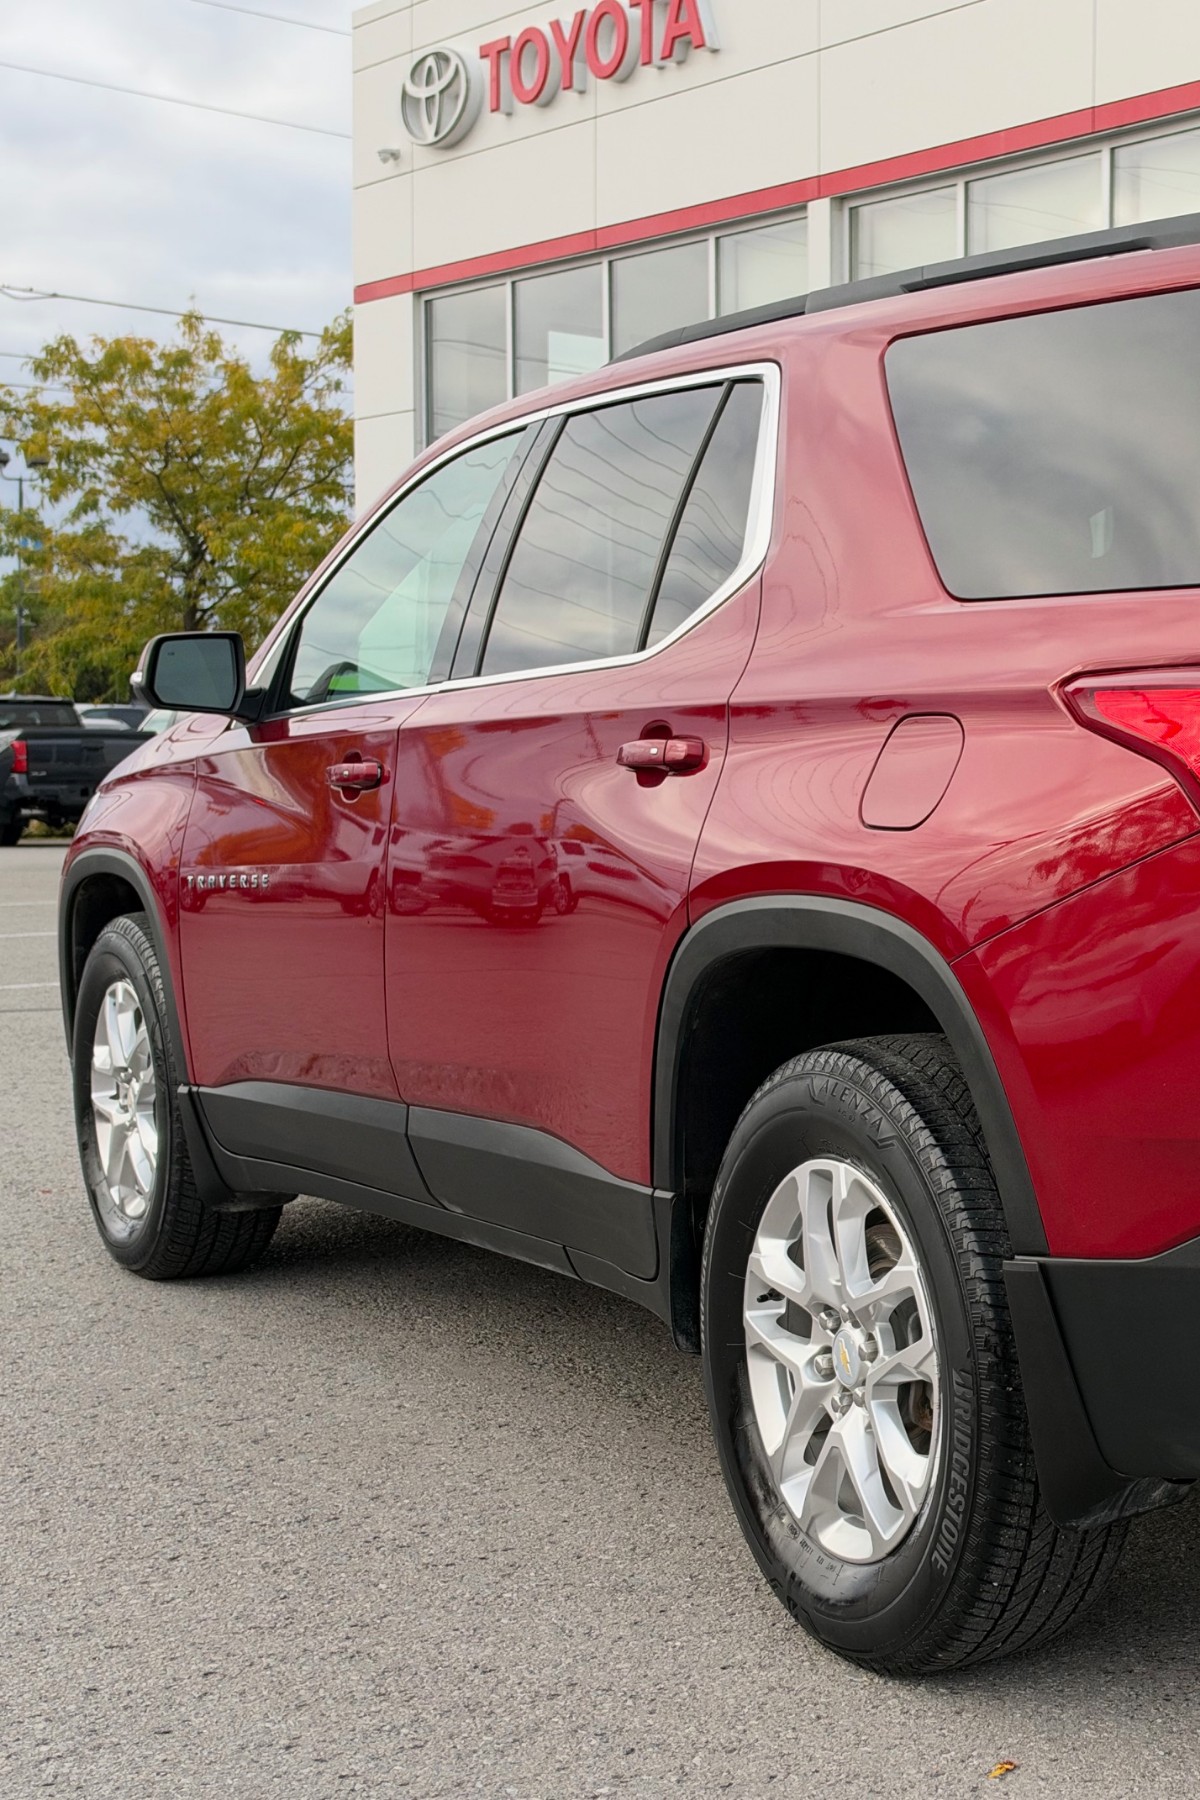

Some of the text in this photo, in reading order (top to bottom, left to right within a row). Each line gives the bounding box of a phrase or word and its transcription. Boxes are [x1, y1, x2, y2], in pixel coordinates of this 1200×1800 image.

[479, 0, 707, 114] TOYOTA
[187, 873, 270, 889] TRAVERSE
[818, 1079, 884, 1134] ALENZA
[931, 1367, 974, 1577] BRIDGESTONE
